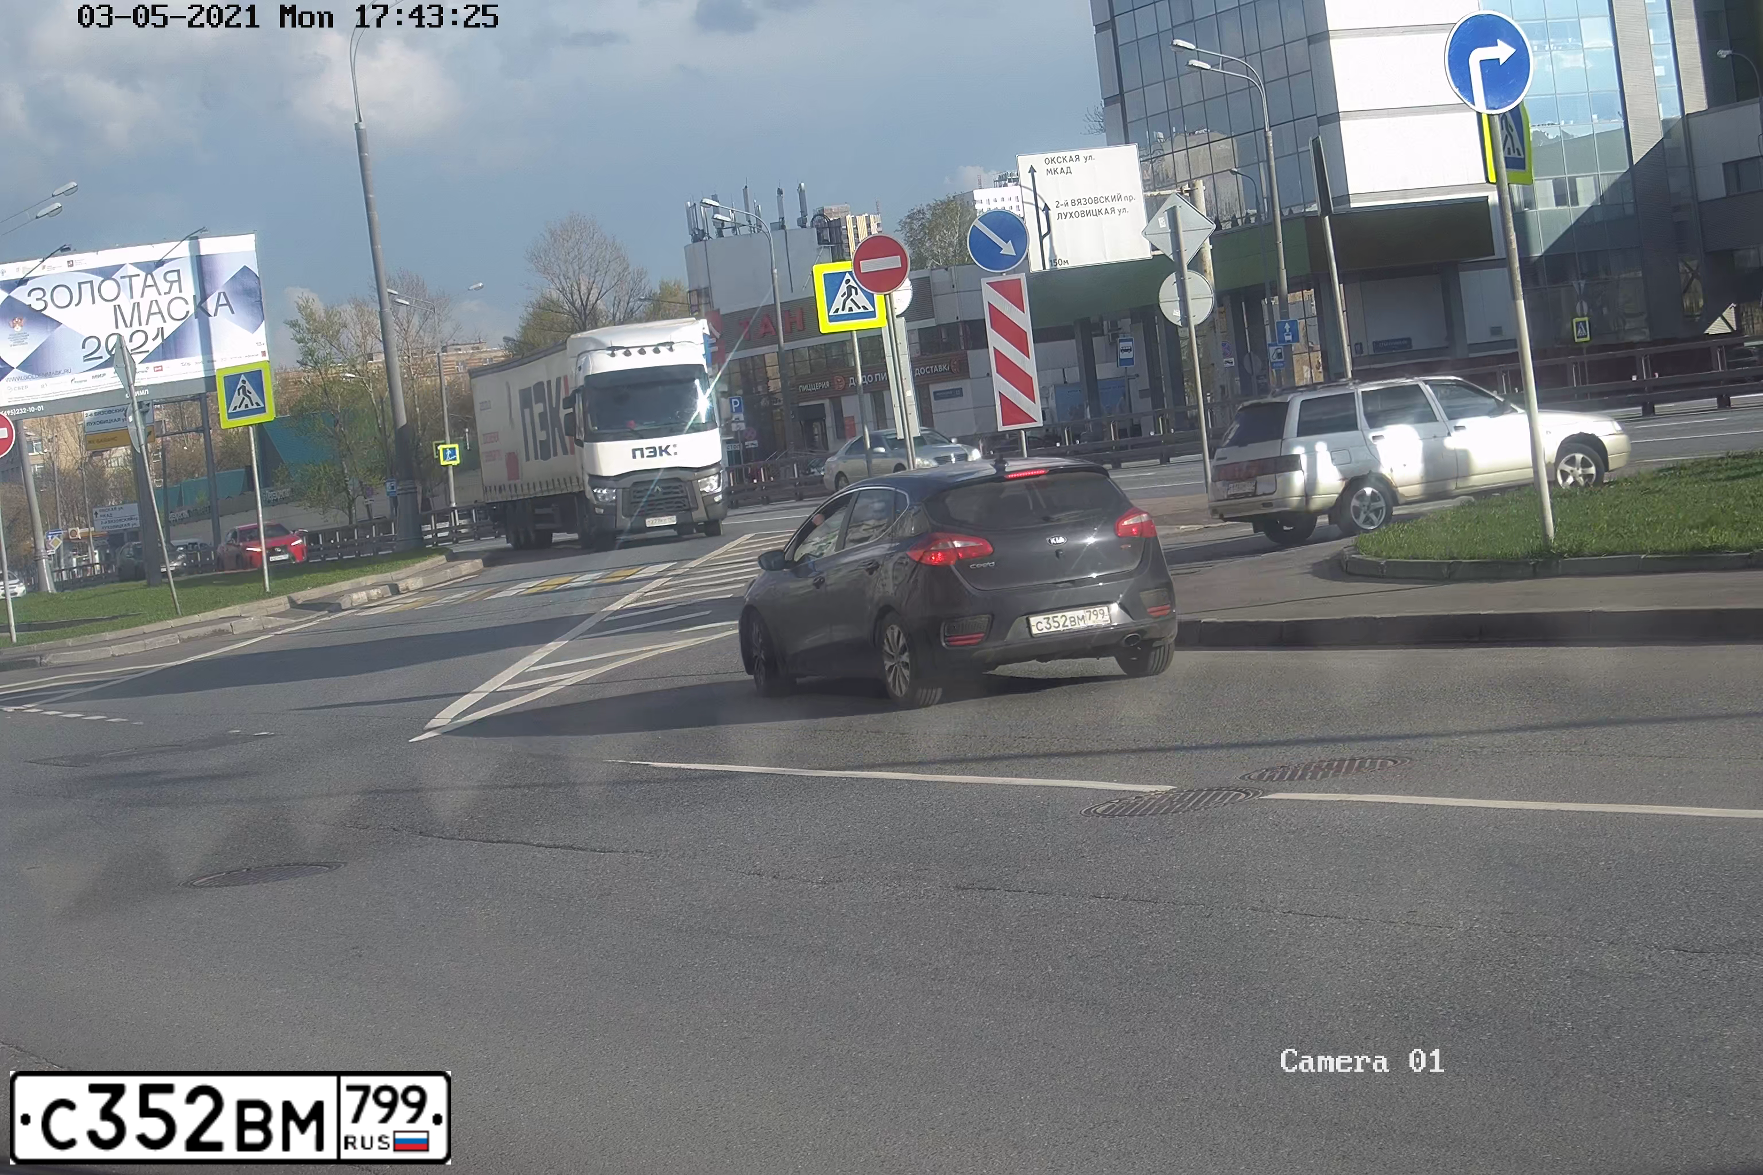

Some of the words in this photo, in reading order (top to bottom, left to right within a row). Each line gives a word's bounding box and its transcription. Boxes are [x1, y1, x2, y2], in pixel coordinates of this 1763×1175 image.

[1044, 154, 1080, 165] ОКСКАЯ
[1083, 155, 1095, 164] ул.
[1046, 166, 1072, 176] МКАД
[1055, 199, 1069, 209] 2-й
[1070, 192, 1123, 207] ВЯЗОВСКИЙ
[1056, 208, 1116, 221] ЛУХОВИЦКАЯ
[27, 268, 183, 311] ЗОЛОТАЯ
[113, 292, 235, 330] МАСКА
[82, 326, 164, 362] 2021
[1035, 614, 1085, 632] С352ВМ
[1086, 608, 1105, 621] 799
